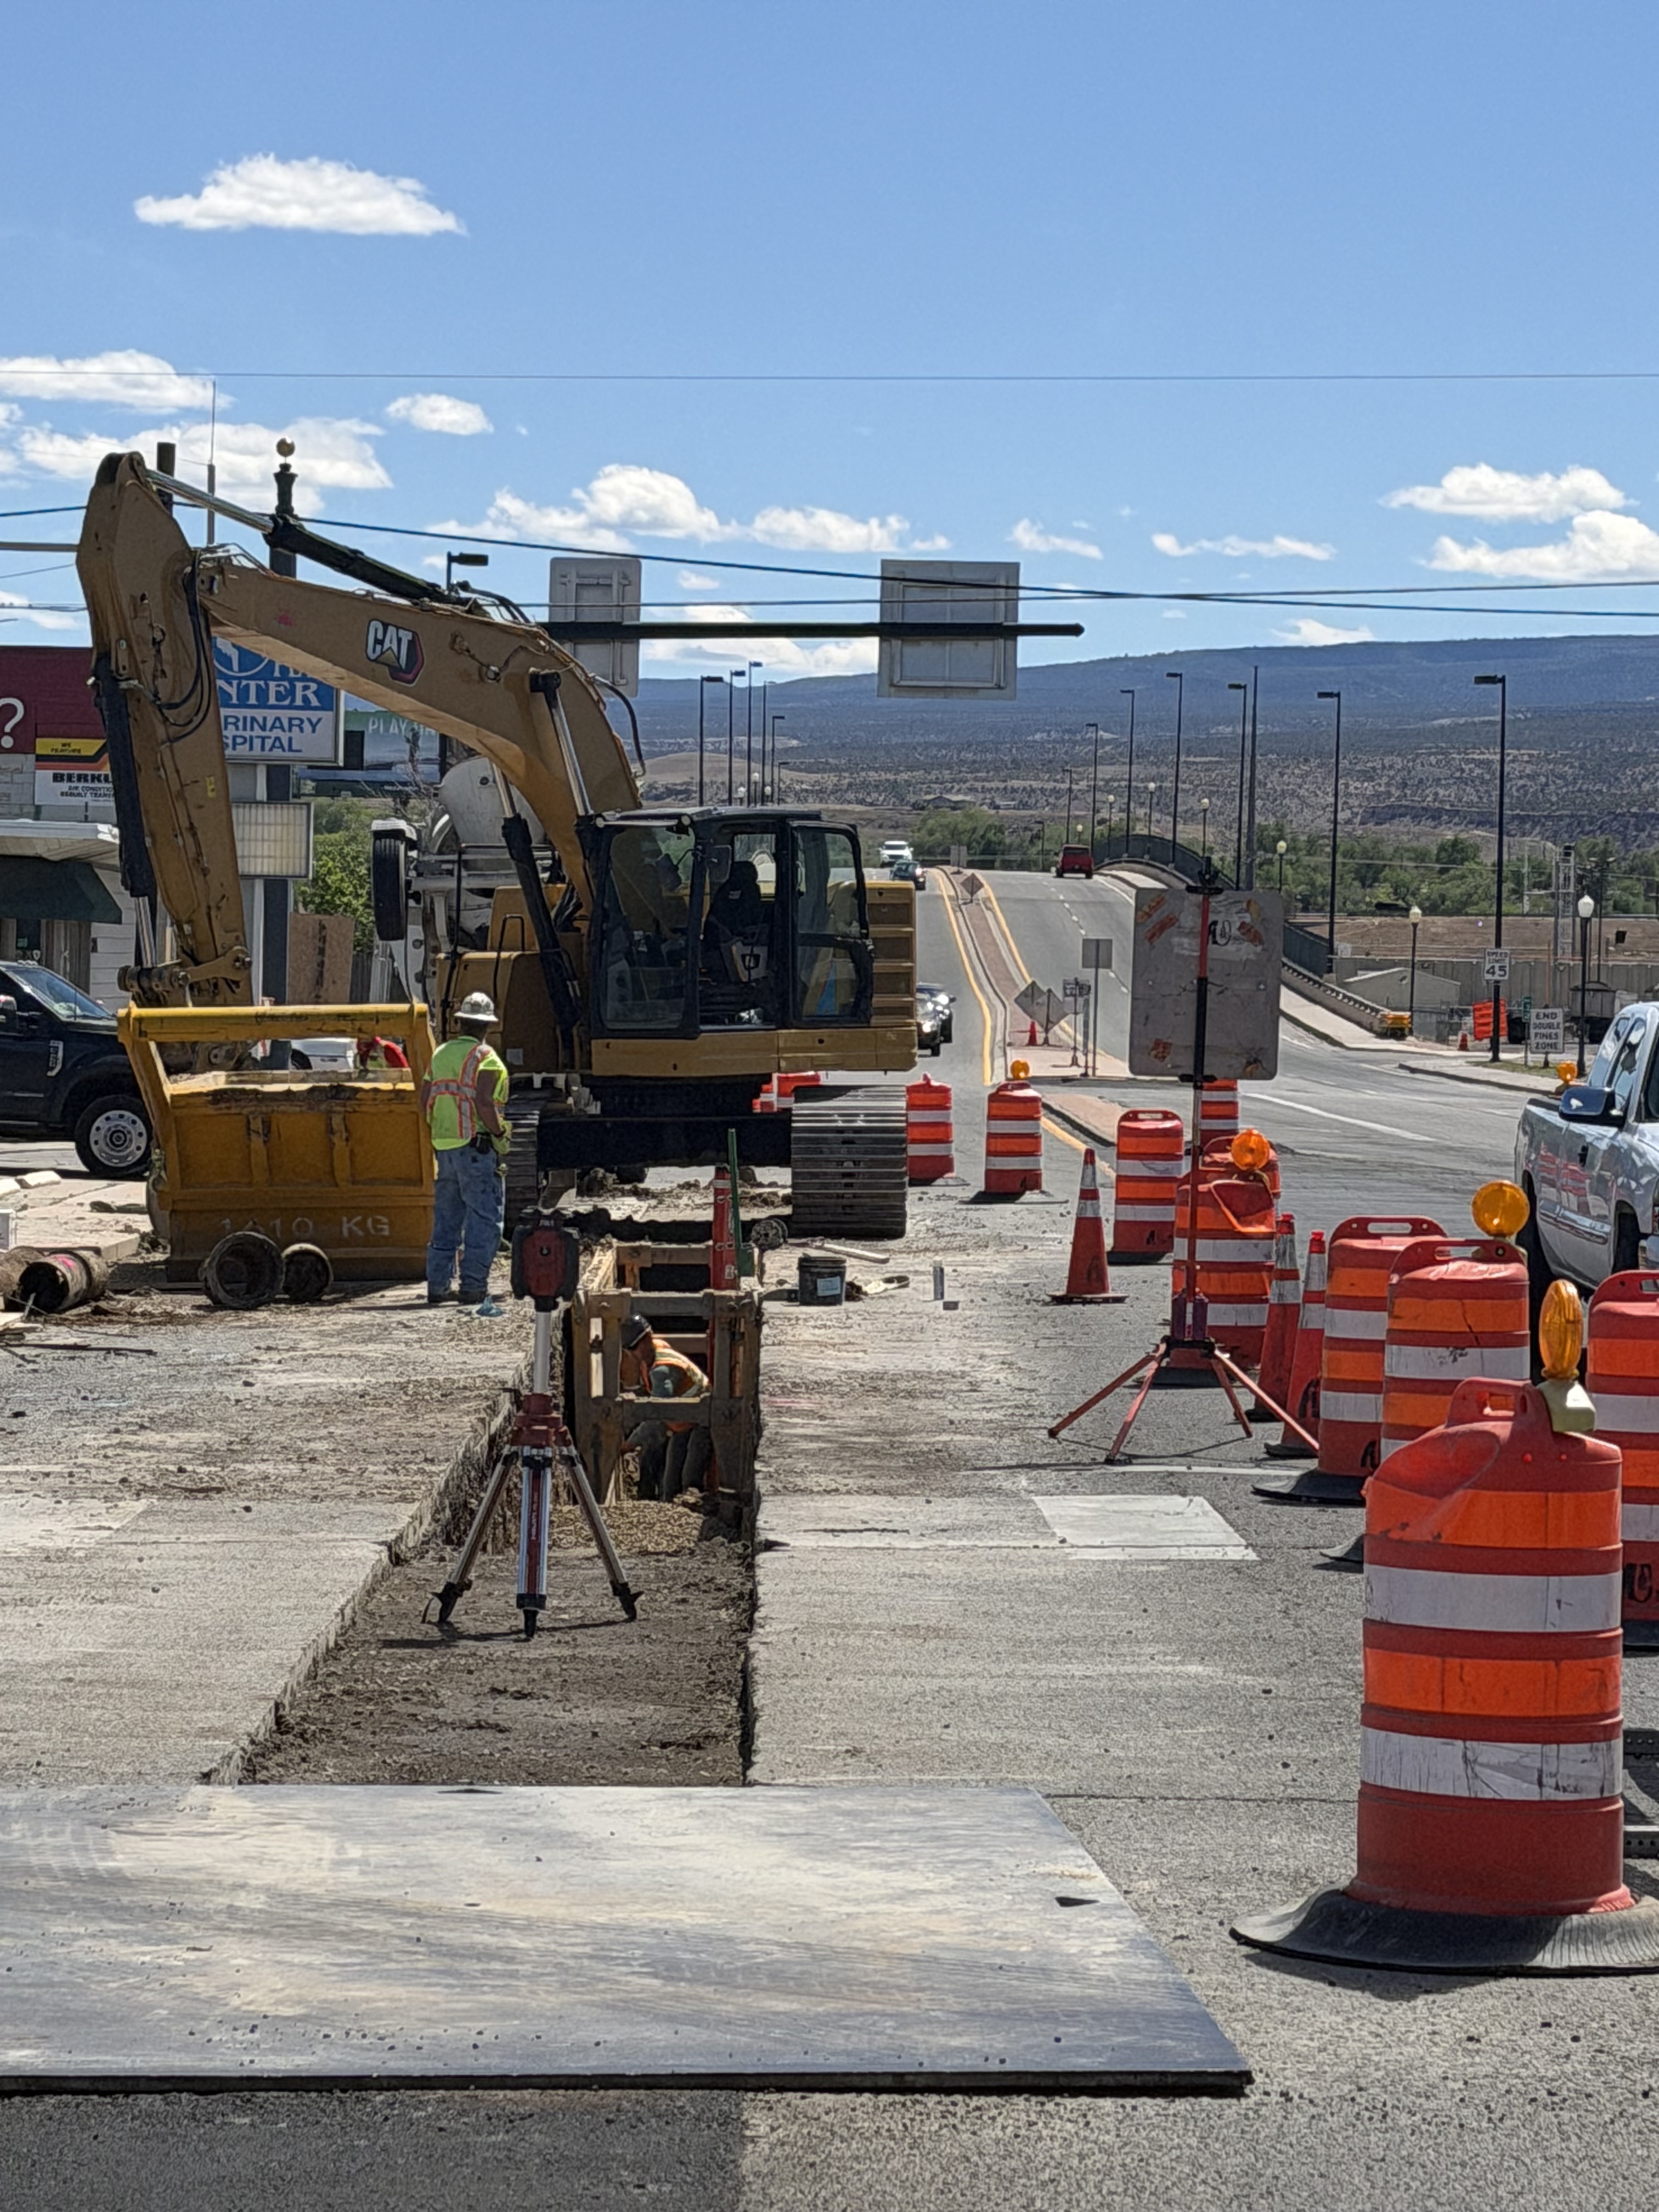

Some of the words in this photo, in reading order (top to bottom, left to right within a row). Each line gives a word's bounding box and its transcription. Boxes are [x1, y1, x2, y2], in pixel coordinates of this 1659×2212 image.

[367, 620, 412, 670] CAT
[1486, 964, 1507, 977] 45
[1536, 1012, 1557, 1020] END
[1532, 1022, 1561, 1030] DOUBLE
[1534, 1031, 1559, 1040] FINES
[1535, 1042, 1558, 1050] ZONE
[342, 1215, 390, 1237] KG
